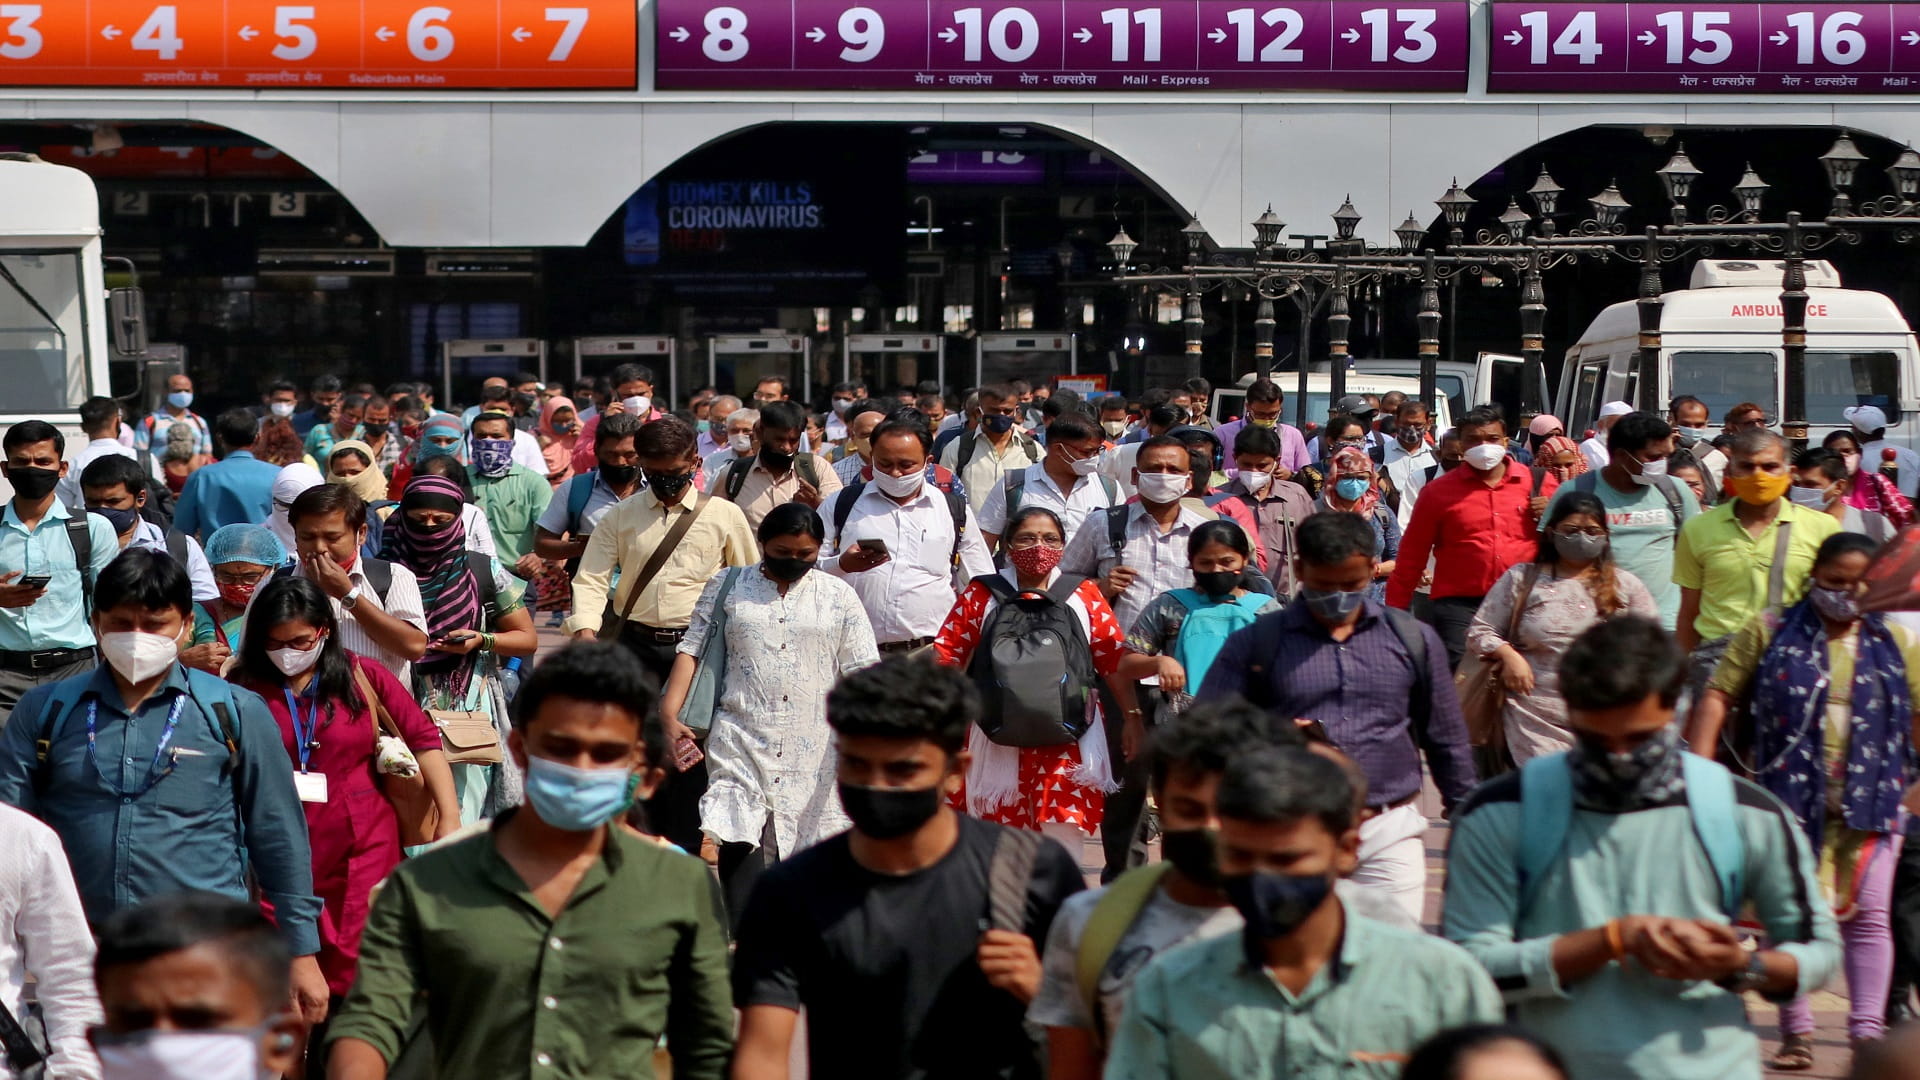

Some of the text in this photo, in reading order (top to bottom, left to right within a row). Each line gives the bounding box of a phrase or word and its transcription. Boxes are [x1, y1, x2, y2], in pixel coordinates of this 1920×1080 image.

[0, 4, 589, 61] 3 4 5 6 7
[702, 6, 1437, 63] 8 9 10 11 12 13
[1520, 10, 1866, 65] 14 15 16
[349, 74, 445, 84] Suburban Main
[915, 72, 934, 84] मेल
[948, 72, 993, 85] एक्सप्रेस
[1019, 72, 1038, 84] मेल
[1053, 72, 1097, 85] एक्सप्रेस
[1122, 75, 1148, 85] Mail
[1161, 75, 1210, 86] Express
[1679, 74, 1698, 86] मेल
[1712, 74, 1756, 87] एक्सप्रेस
[1781, 74, 1801, 86] मेल
[1814, 74, 1859, 87] एक्सप्रेस
[1882, 77, 1908, 86] Mail
[279, 191, 296, 211] 3
[1731, 304, 1828, 317] AMBULCE
